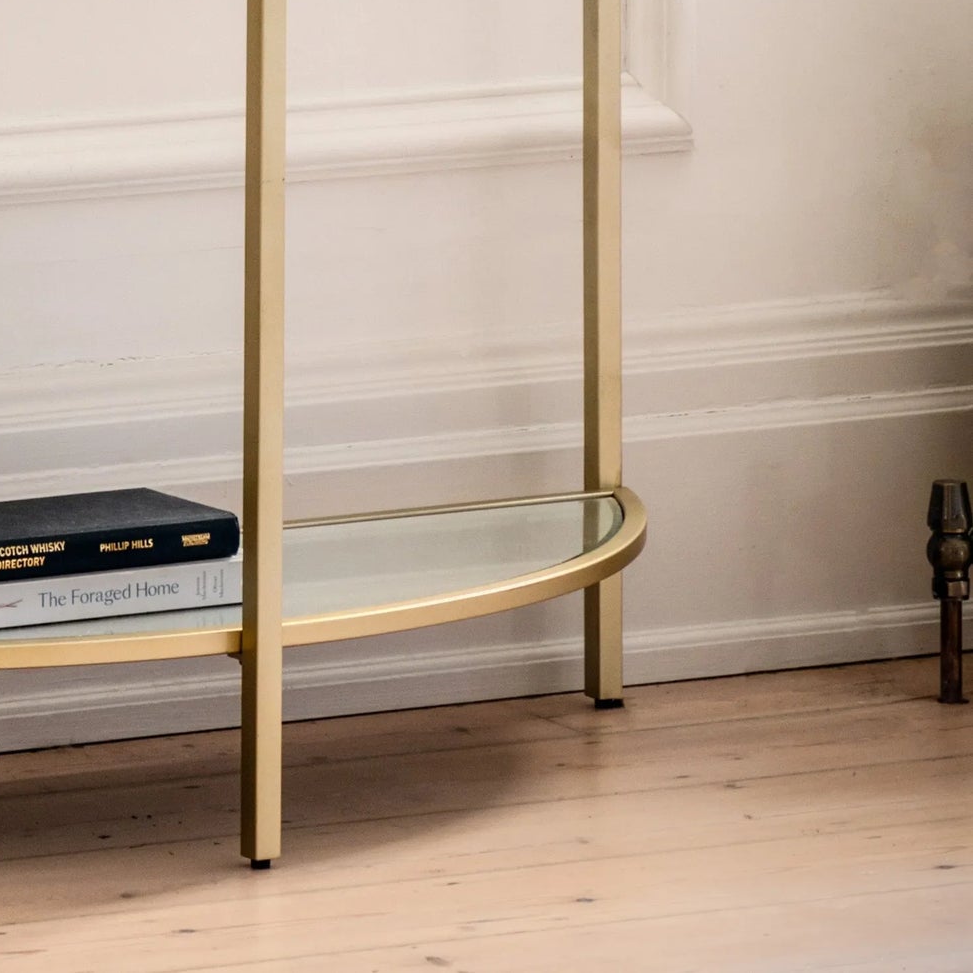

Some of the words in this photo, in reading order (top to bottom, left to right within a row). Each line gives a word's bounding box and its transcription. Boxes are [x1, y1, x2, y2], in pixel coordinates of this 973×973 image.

[29, 540, 66, 554] WHISKY
[99, 541, 130, 553] PHILLIP
[131, 538, 154, 549] HILLS
[38, 591, 67, 608] The
[71, 583, 131, 606] Foraged
[136, 581, 180, 598] Home
